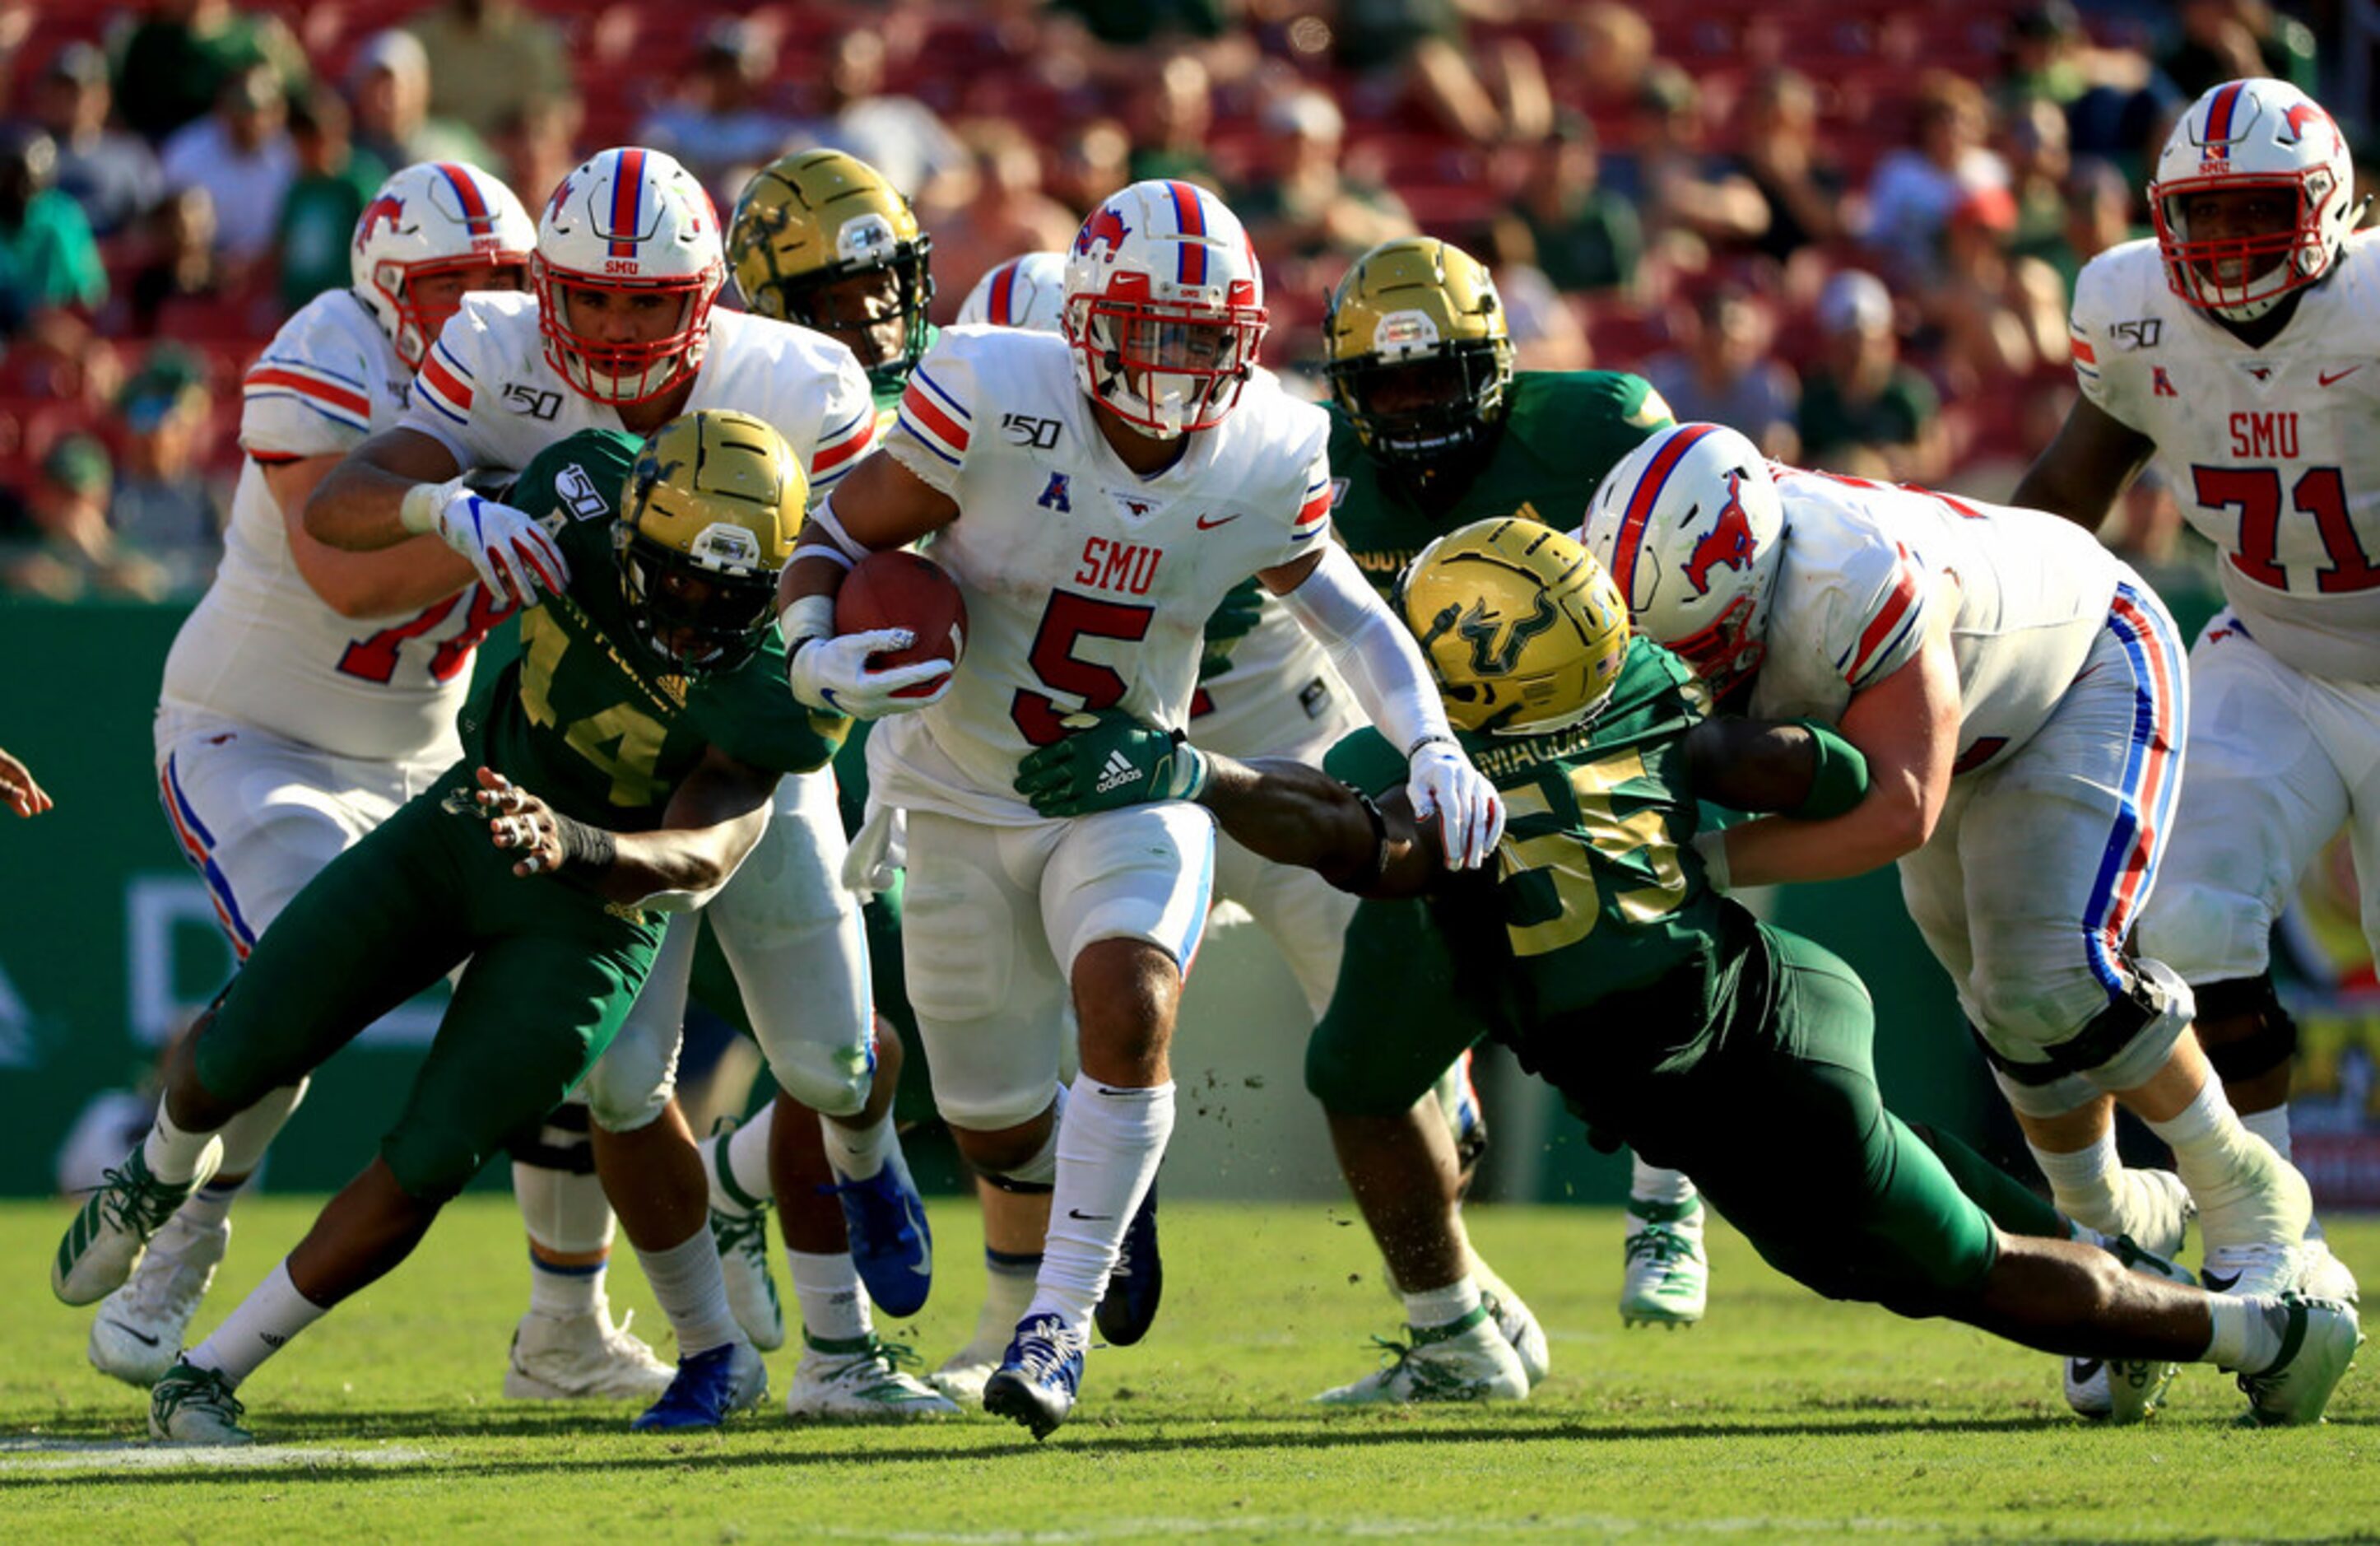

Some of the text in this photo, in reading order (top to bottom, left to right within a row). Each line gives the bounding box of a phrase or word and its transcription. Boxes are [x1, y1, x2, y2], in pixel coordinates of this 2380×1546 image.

[605, 259, 639, 276] SMU
[2110, 319, 2162, 352] 150
[503, 382, 564, 421] 150
[1002, 412, 1062, 450] 150
[2229, 412, 2300, 459] SMU
[556, 463, 607, 518] 150
[2190, 463, 2380, 594] 71
[1075, 537, 1163, 595] SMU
[1010, 587, 1156, 747] 5
[1095, 767, 1144, 794] adidas
[1496, 743, 1687, 957] 55
